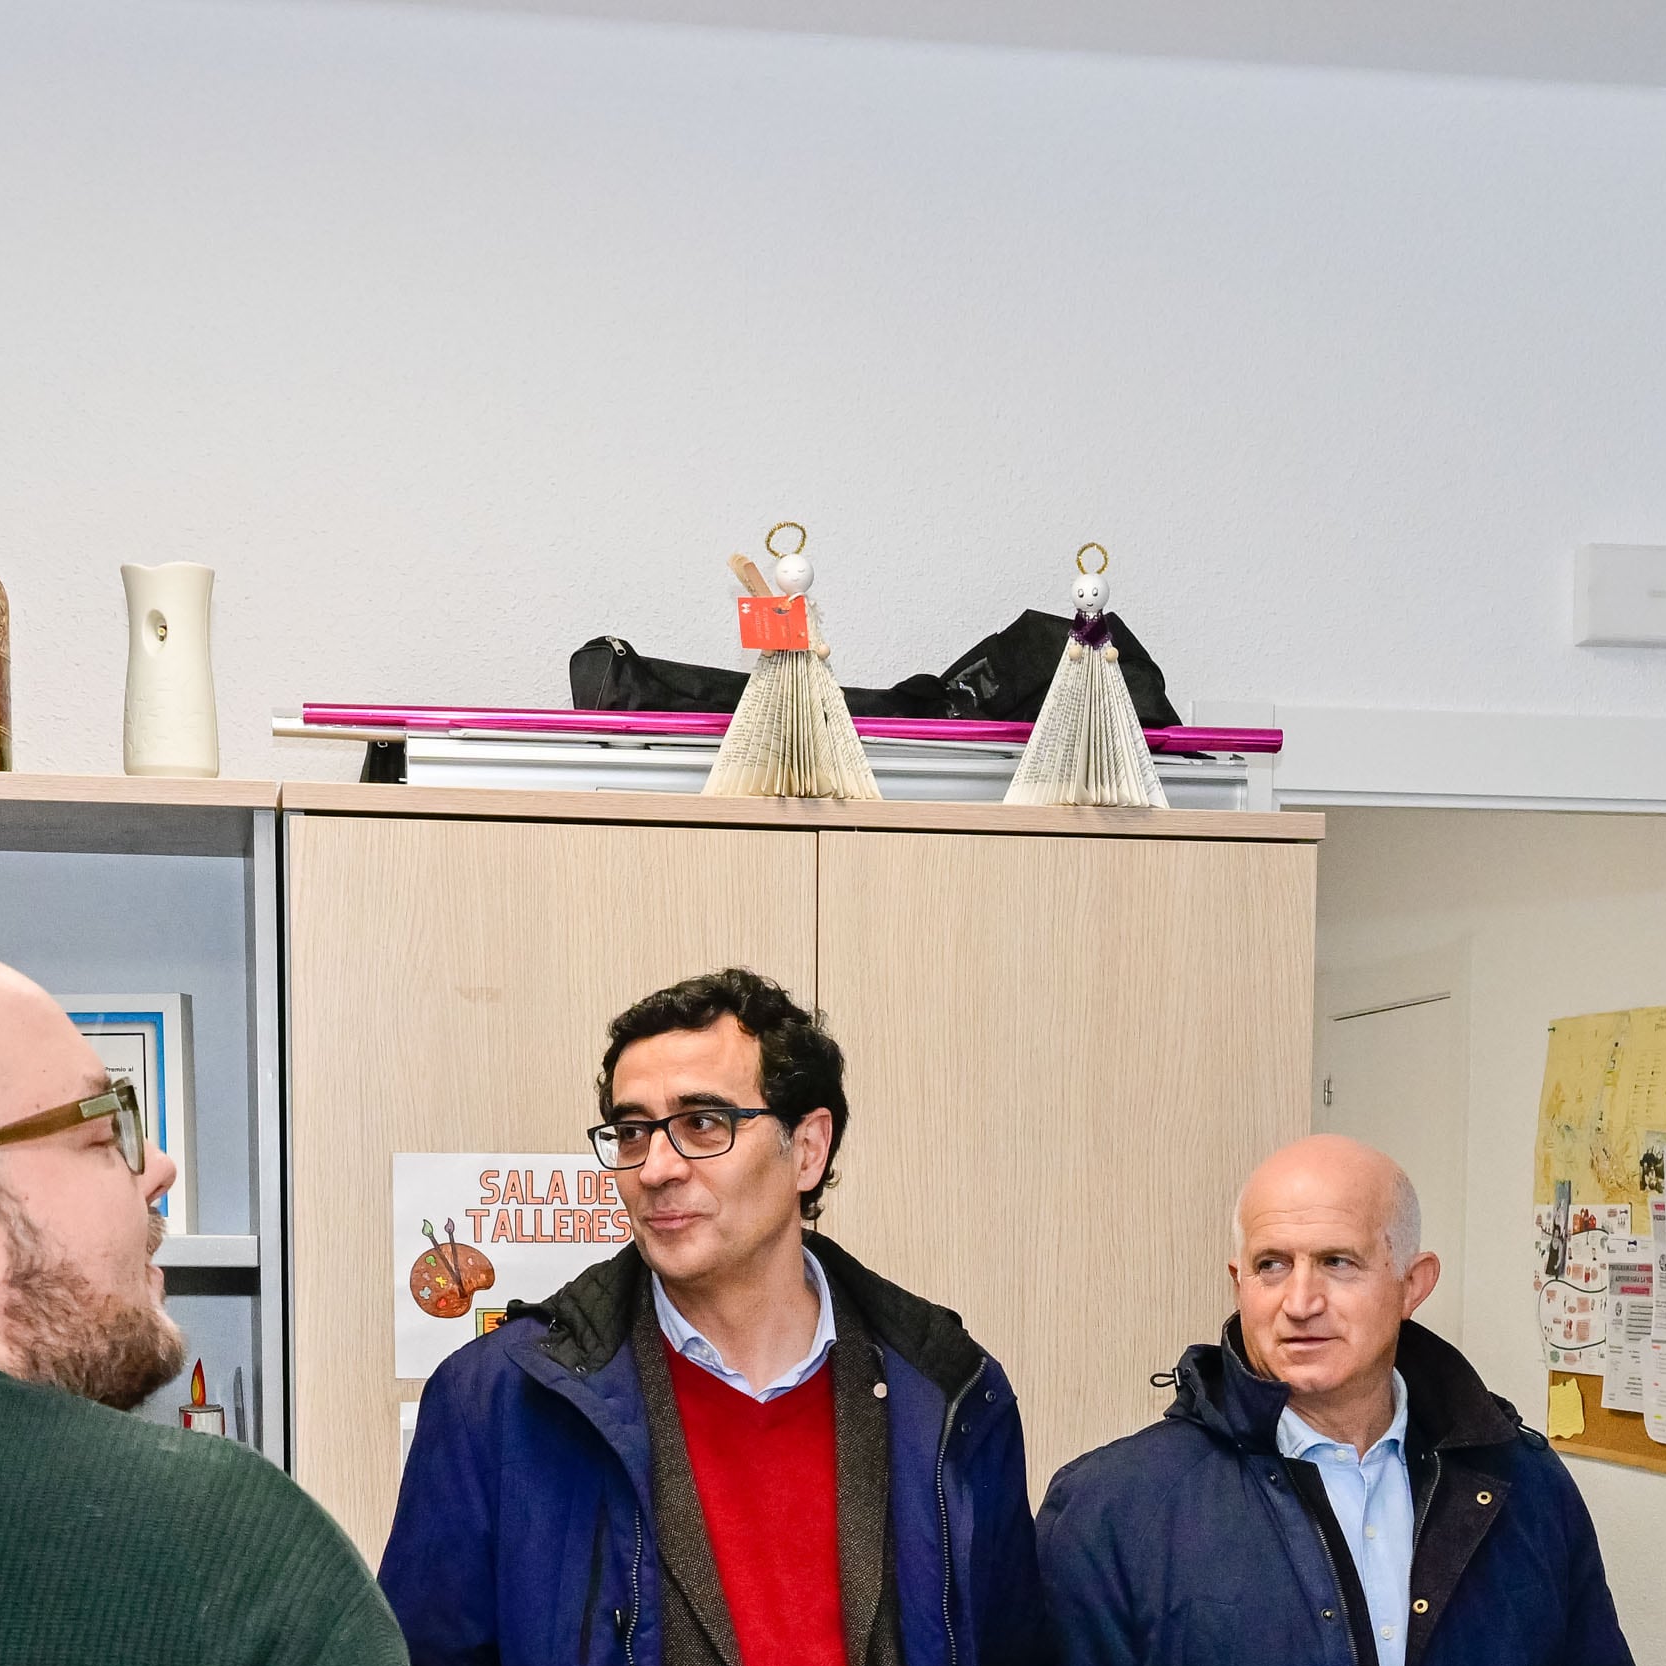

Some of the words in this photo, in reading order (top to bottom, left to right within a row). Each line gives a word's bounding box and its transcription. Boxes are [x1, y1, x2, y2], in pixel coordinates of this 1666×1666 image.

[480, 1170, 568, 1204] SALA
[577, 1171, 617, 1204] DE
[465, 1209, 632, 1243] TALLERES
